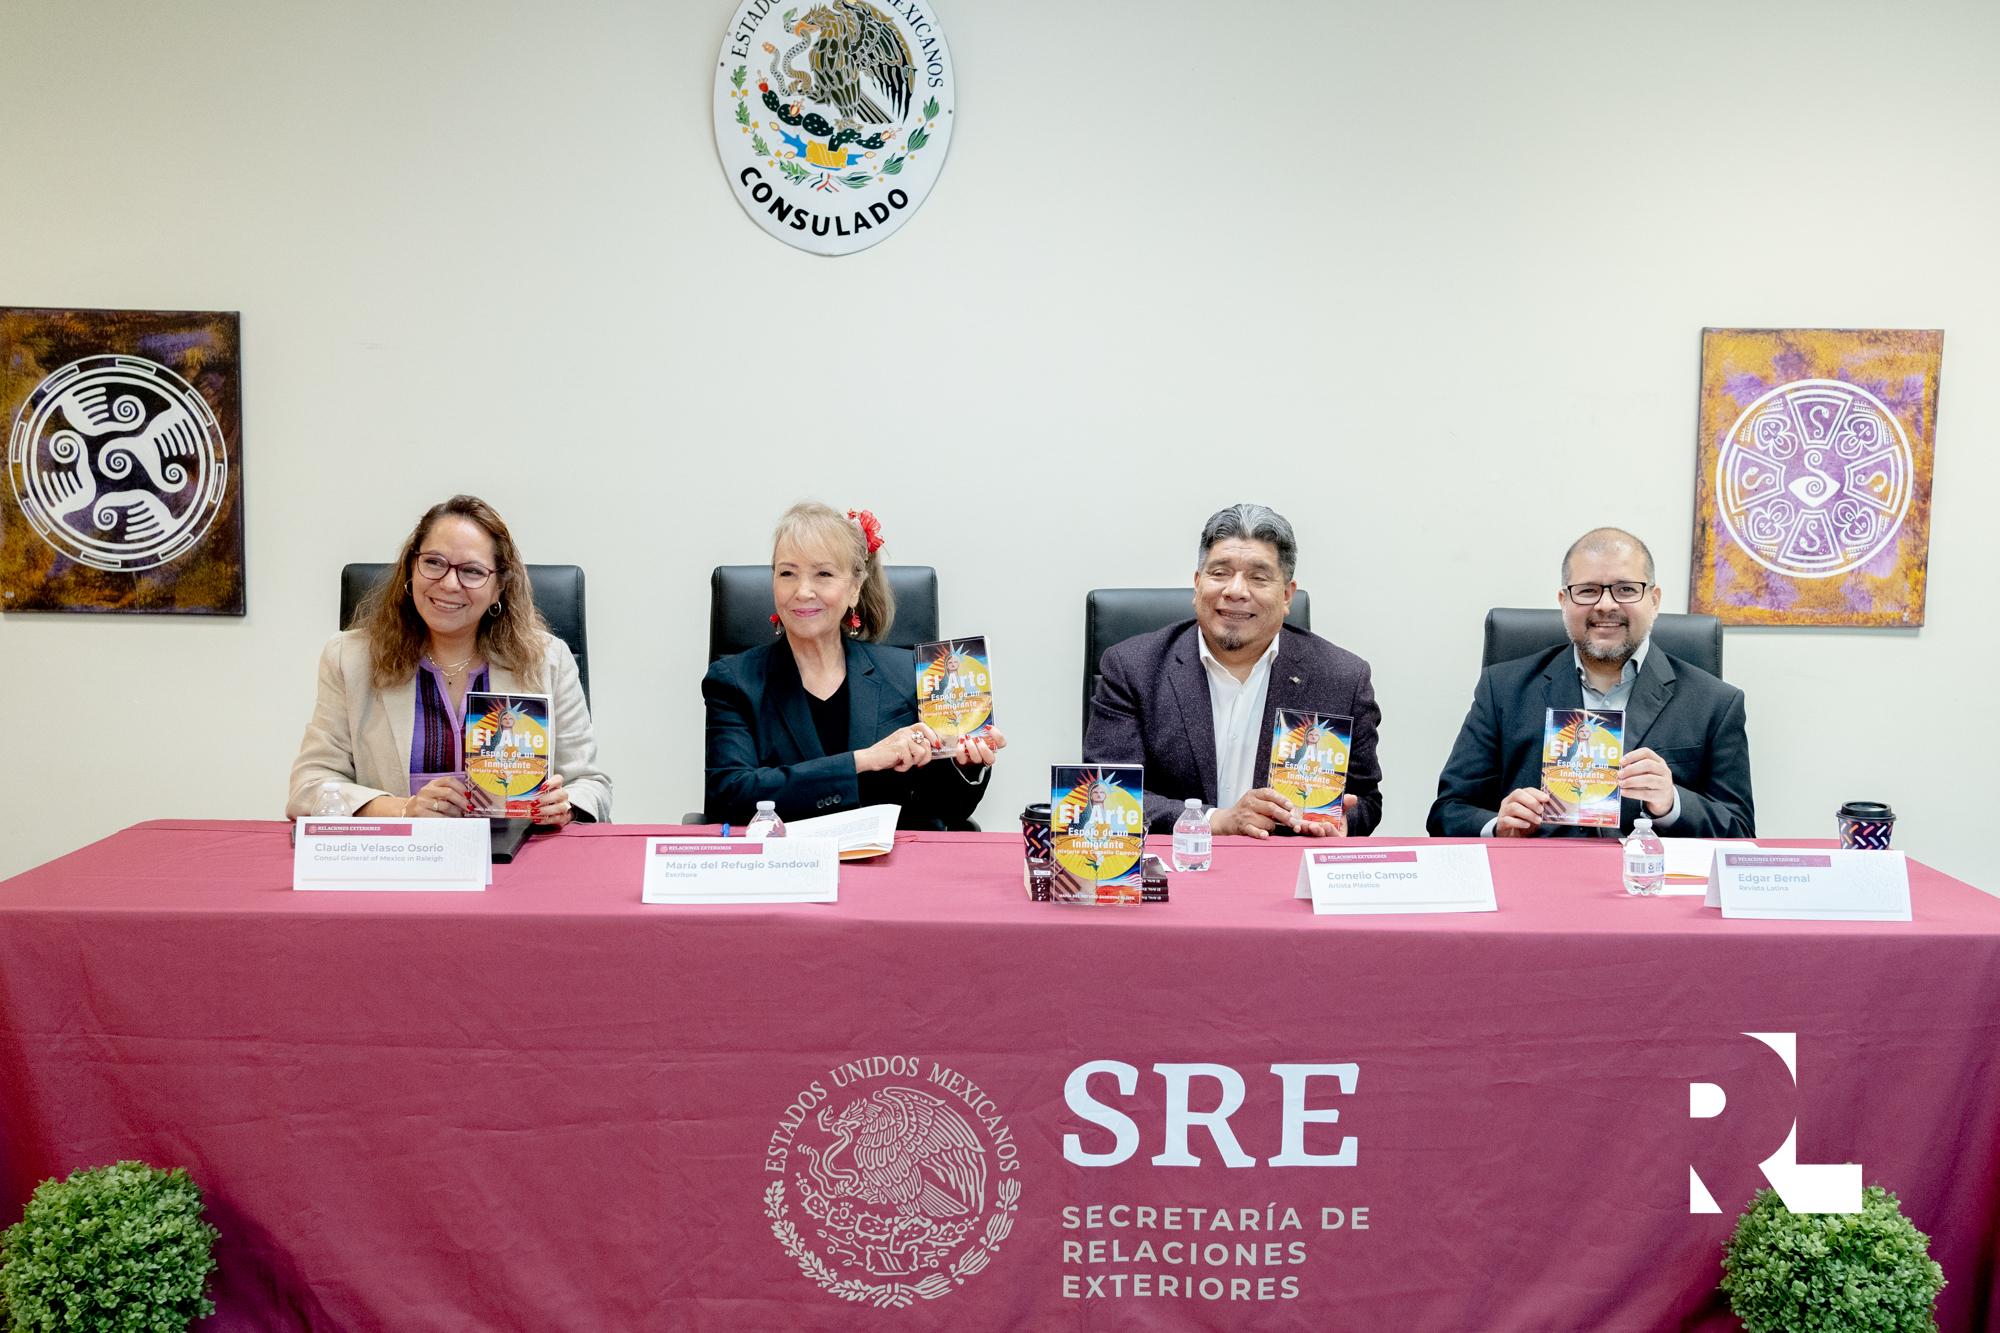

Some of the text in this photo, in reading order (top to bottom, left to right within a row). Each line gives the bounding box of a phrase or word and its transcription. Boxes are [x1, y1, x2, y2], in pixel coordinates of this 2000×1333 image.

[731, 0, 944, 88] ESTAD EXICANOS
[740, 166, 909, 236] CONSULADO
[923, 672, 987, 691] El Arte
[472, 729, 545, 748] El Arte
[1550, 740, 1618, 760] El Arte
[1279, 741, 1345, 766] El Arte
[1059, 804, 1139, 826] El Arte
[314, 843, 444, 853] Claudia Velasco Osorio
[700, 860, 718, 870] del
[721, 860, 765, 871] Refugio
[768, 860, 819, 869] Sandoval
[1327, 871, 1418, 882] Cornelio Campos
[1739, 873, 1810, 884] Edgar Bernal
[765, 1055, 1020, 1173] ESTADOS UNIDOS MEXICANOS
[1063, 1059, 1360, 1168] SRE
[1062, 1202, 1370, 1231] SECRETARÍA DE
[1063, 1239, 1307, 1266] RELACIONES
[1062, 1274, 1300, 1301] EXTERIORES
